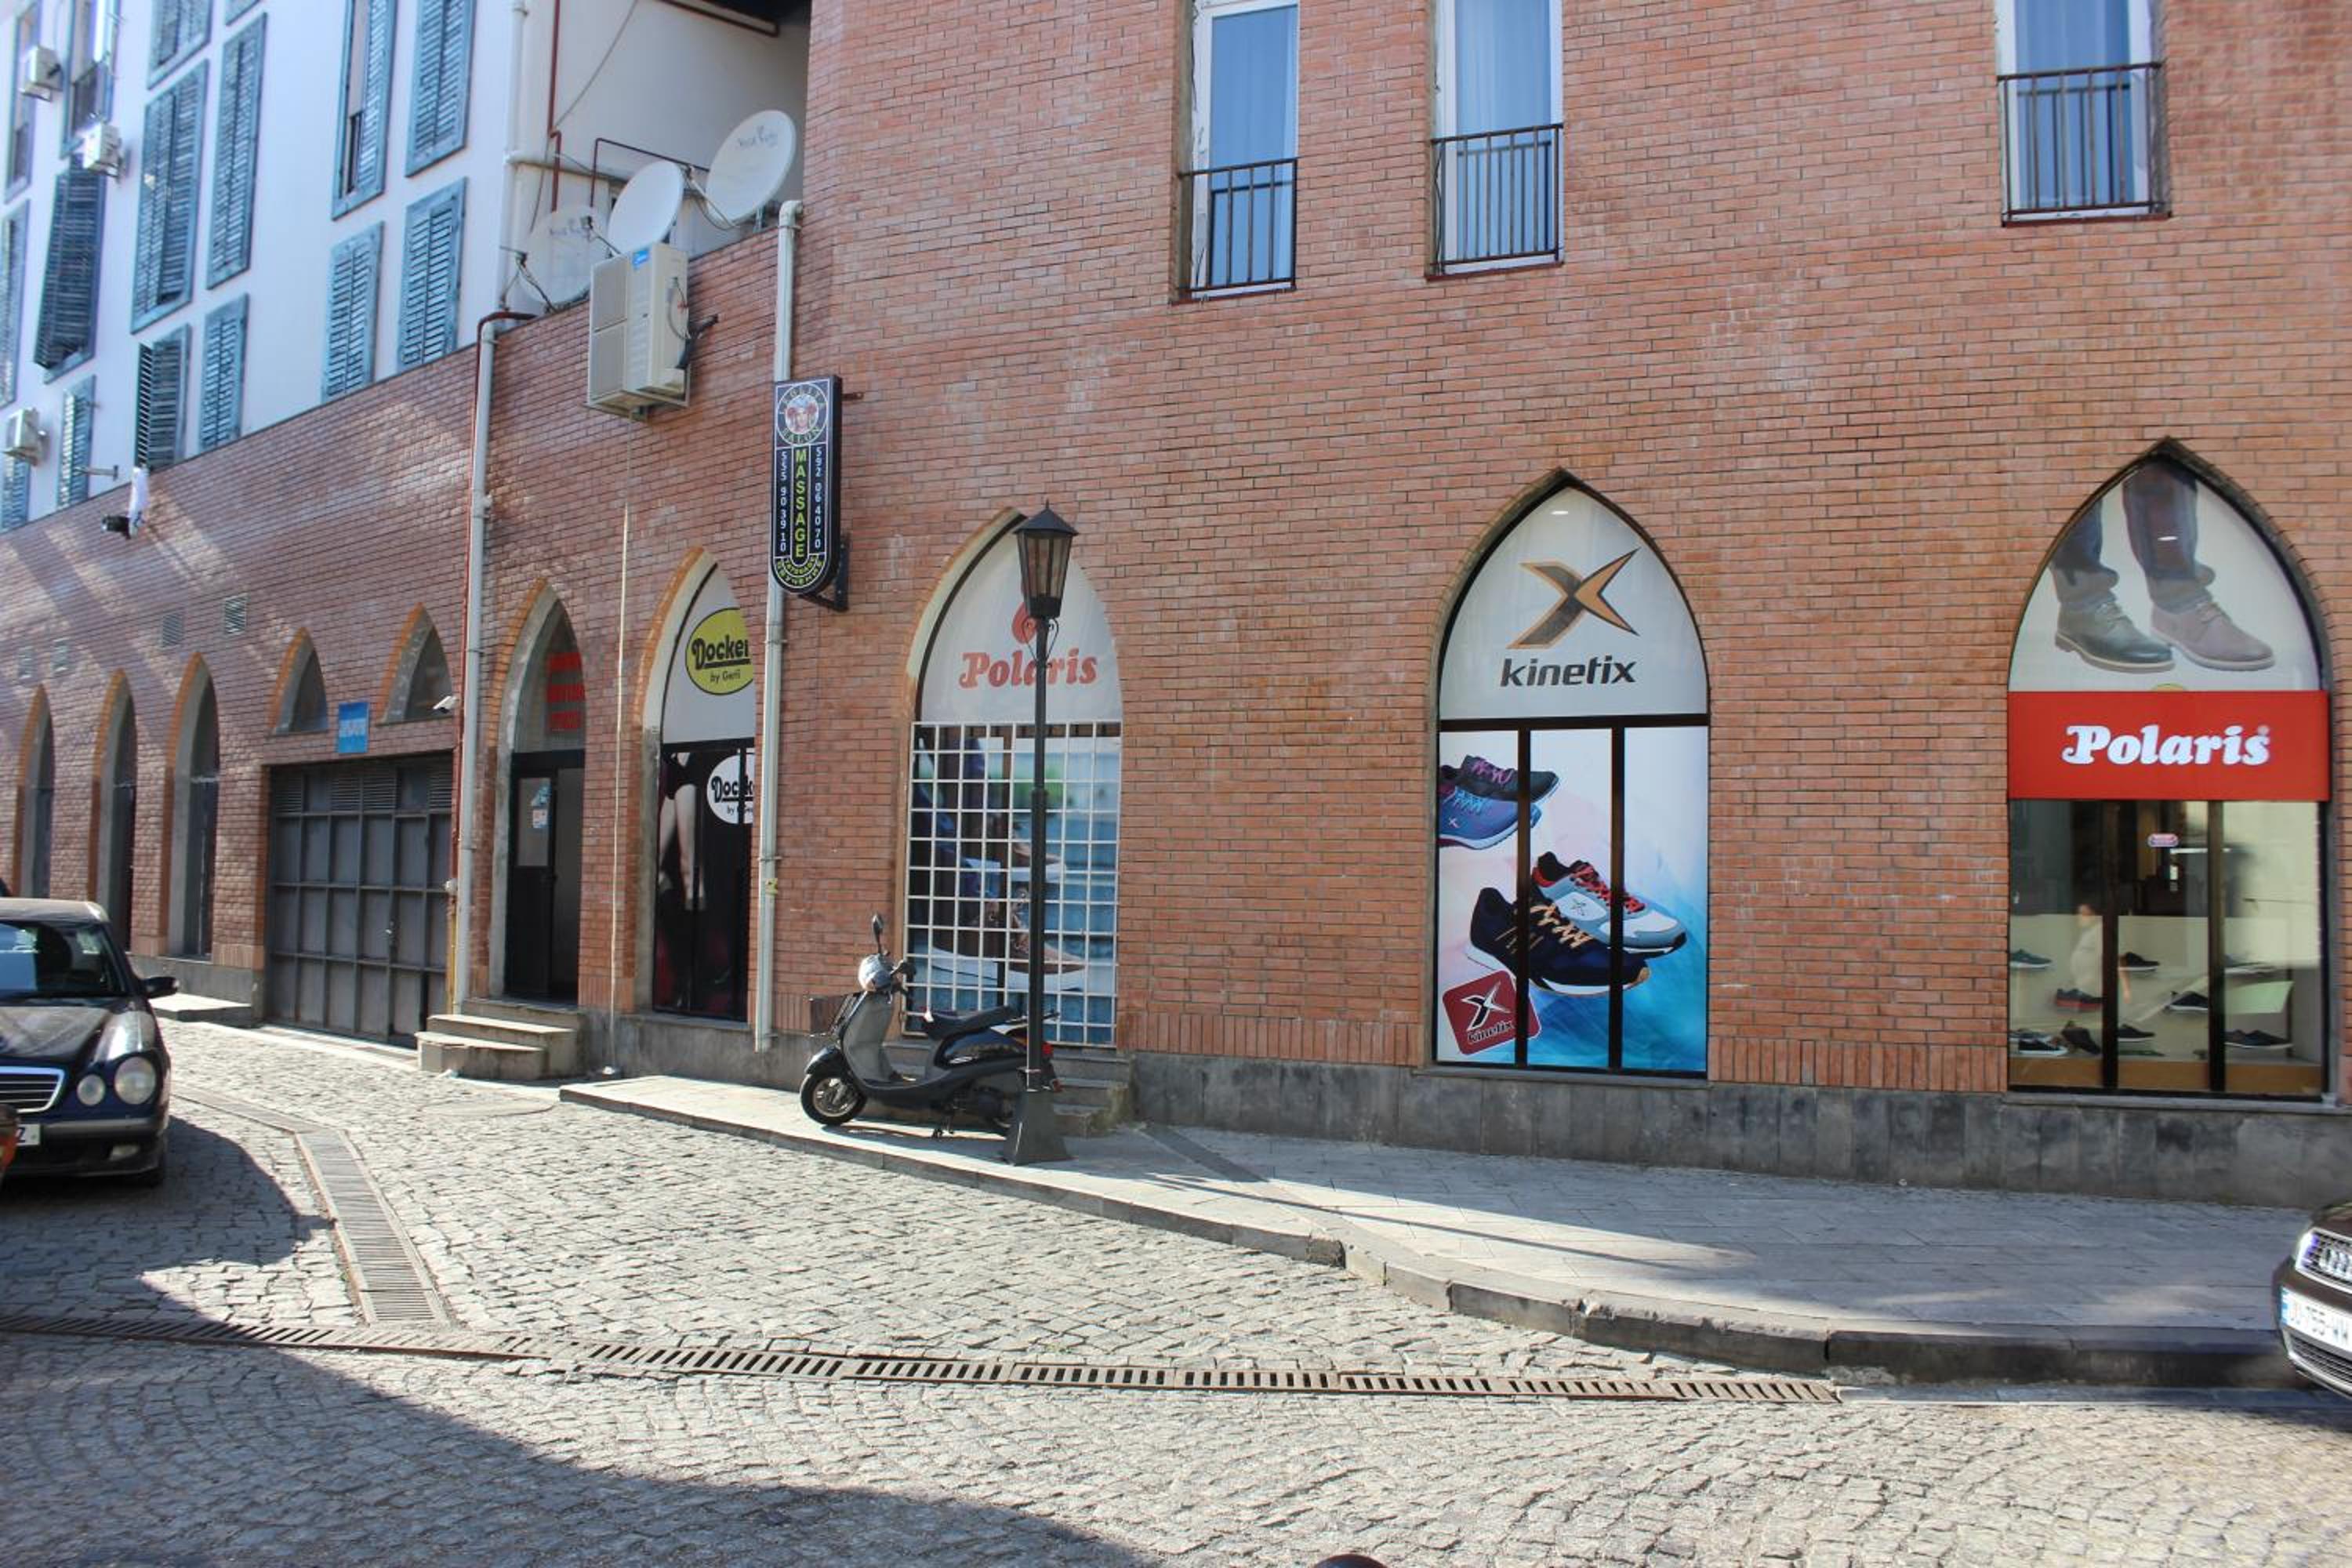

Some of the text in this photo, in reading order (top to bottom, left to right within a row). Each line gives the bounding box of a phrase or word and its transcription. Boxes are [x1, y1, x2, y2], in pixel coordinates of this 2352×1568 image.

[794, 448, 808, 557] MASSAGE
[710, 673, 720, 684] by
[959, 648, 1097, 689] Polaris
[1500, 655, 1639, 687] kinetix
[2062, 724, 2270, 765] Polaris
